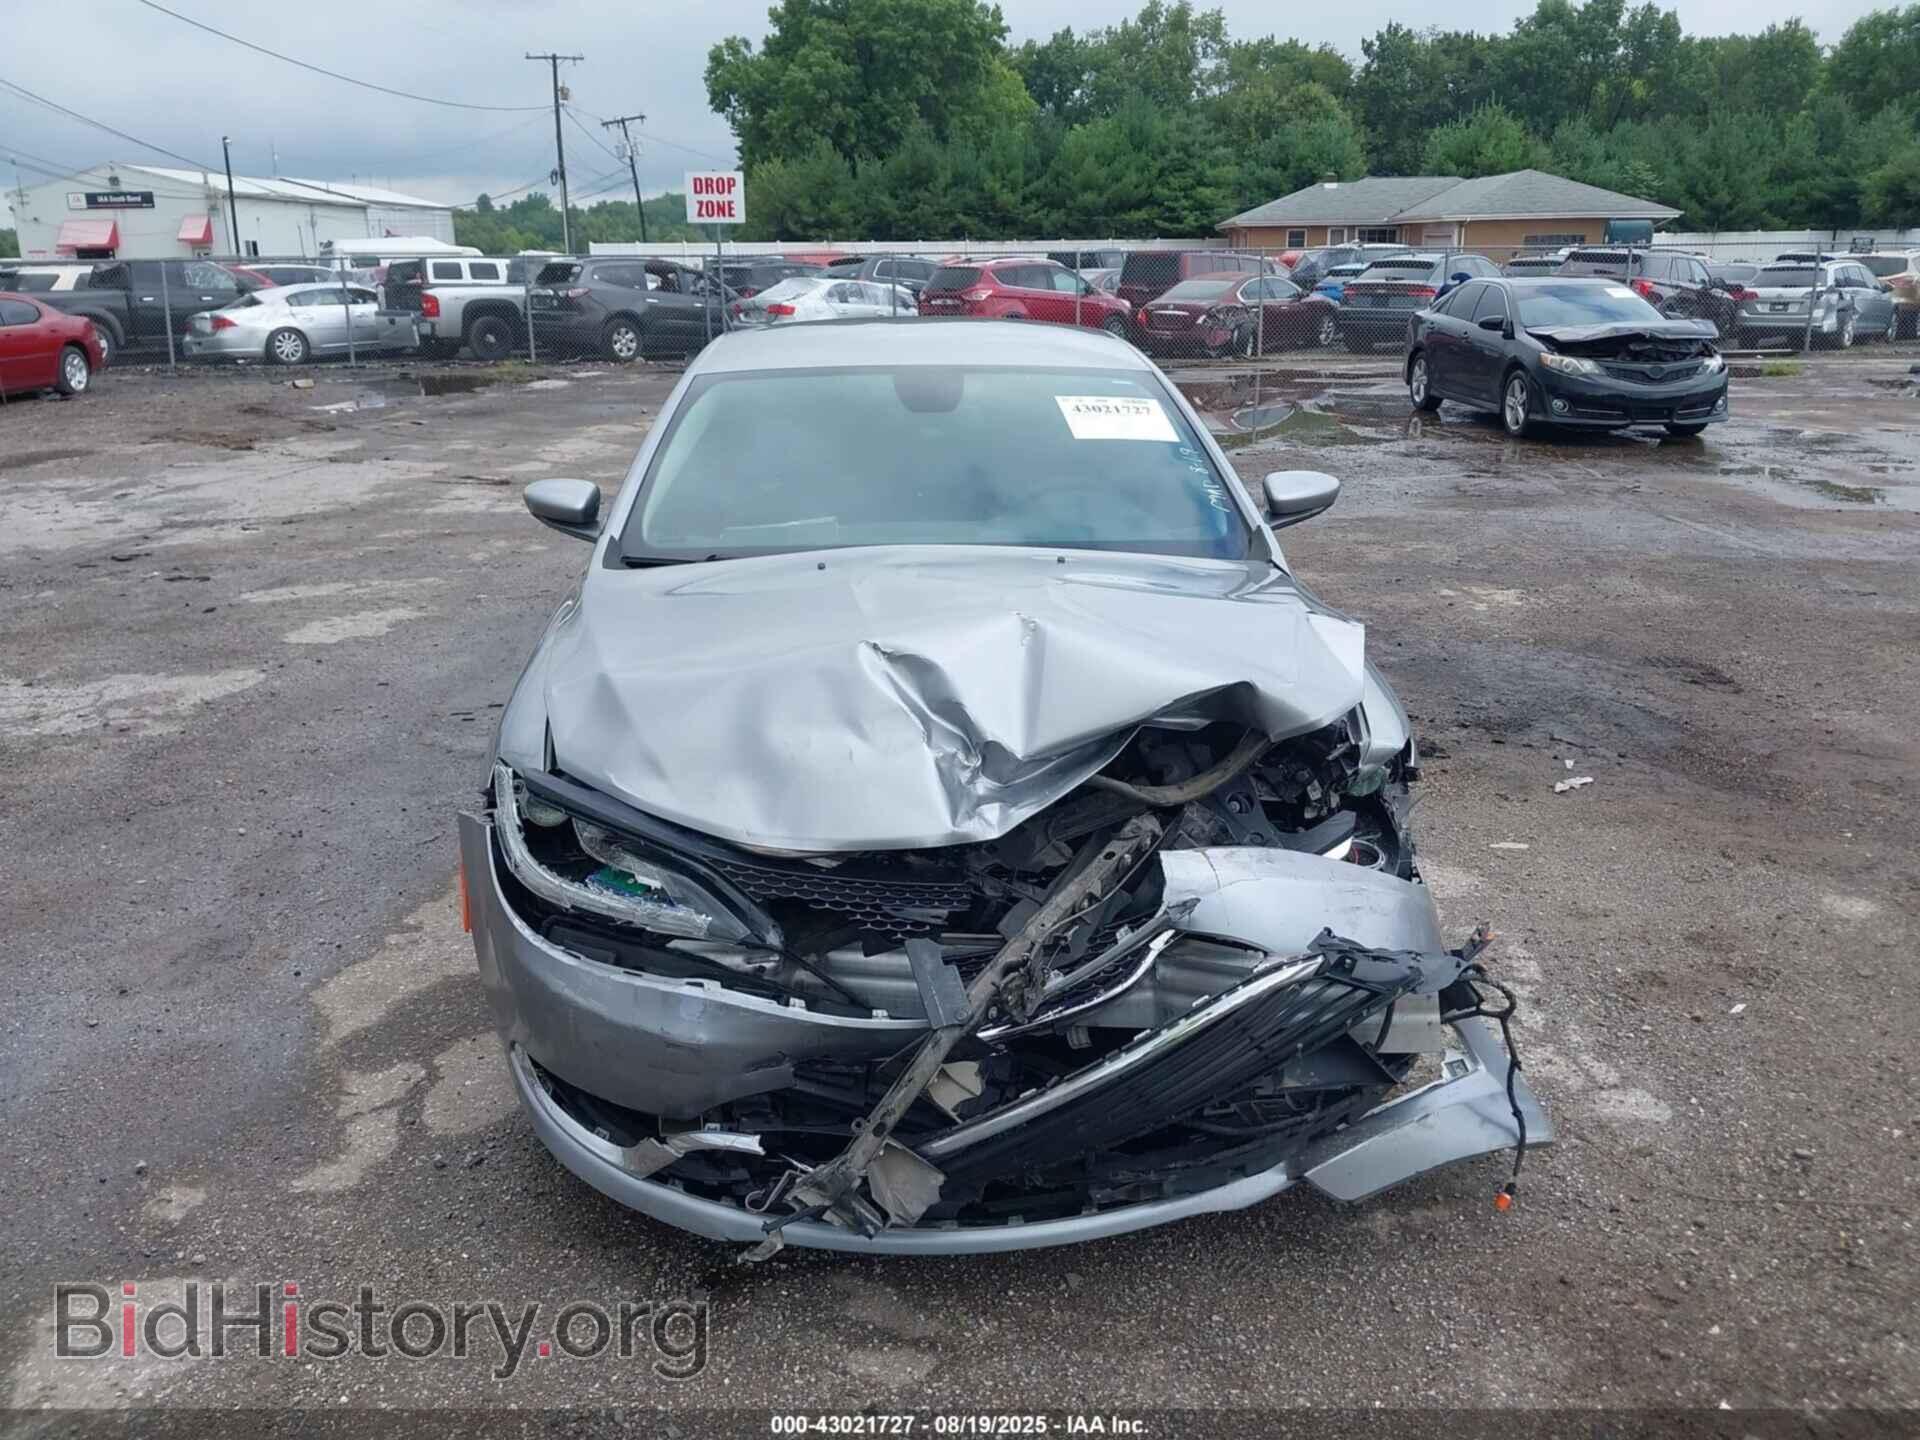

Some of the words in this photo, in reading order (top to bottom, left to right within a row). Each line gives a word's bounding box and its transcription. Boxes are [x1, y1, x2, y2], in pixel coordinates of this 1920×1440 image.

[693, 177, 736, 195] DROP
[696, 200, 736, 218] ZONE
[1072, 404, 1150, 416] 43021727
